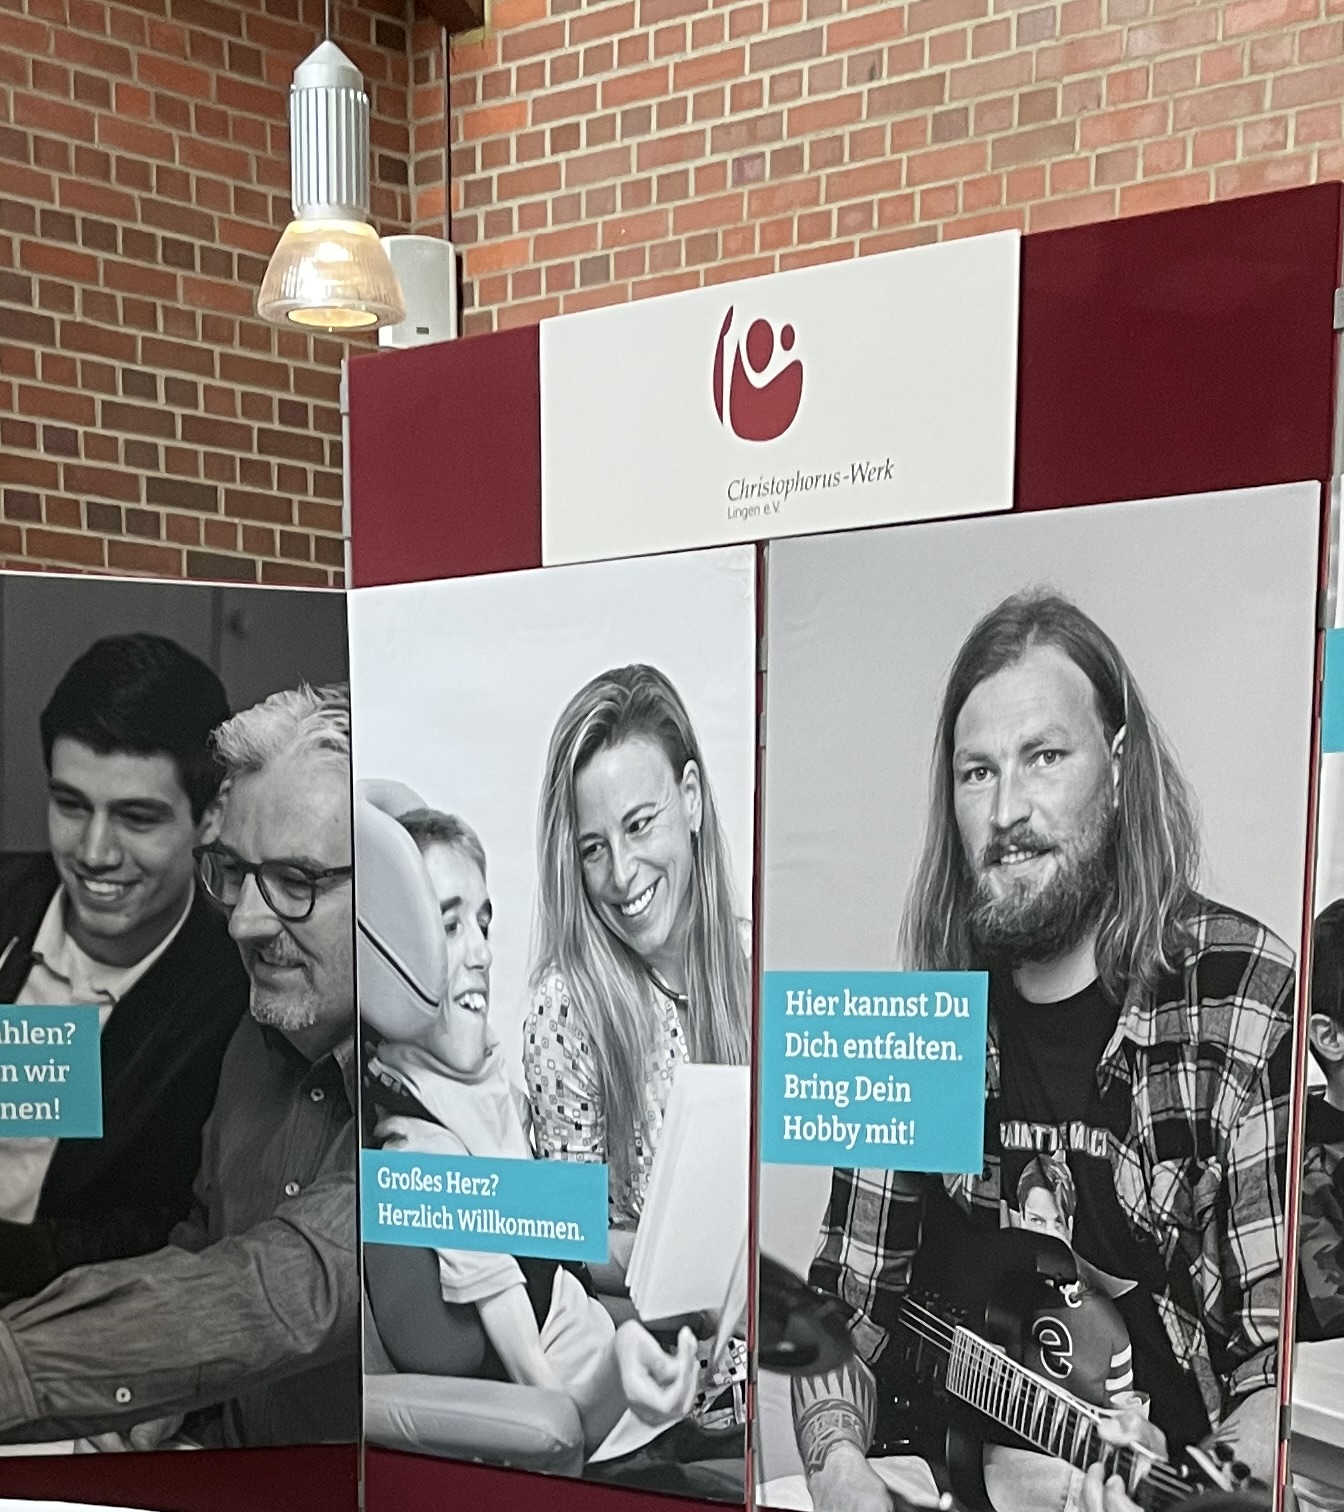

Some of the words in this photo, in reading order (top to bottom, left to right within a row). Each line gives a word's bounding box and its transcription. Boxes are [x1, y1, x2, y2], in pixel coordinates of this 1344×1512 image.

[727, 457, 895, 501] Christophorus-Werk
[727, 504, 761, 521] Lingen
[785, 988, 839, 1016] Hier
[843, 988, 929, 1018] kannst
[934, 991, 970, 1018] Du
[784, 1031, 839, 1058] Dich
[843, 1032, 963, 1061] entfalten.
[23, 1058, 70, 1083] wir
[783, 1072, 850, 1108] Bring
[854, 1075, 912, 1103] Dein
[783, 1114, 861, 1150] Hobby
[864, 1117, 916, 1145] mit!
[377, 1167, 443, 1193] Großes
[446, 1171, 499, 1197] Herz?
[377, 1203, 454, 1230] Herzlich
[457, 1208, 585, 1241] Willkommen.
